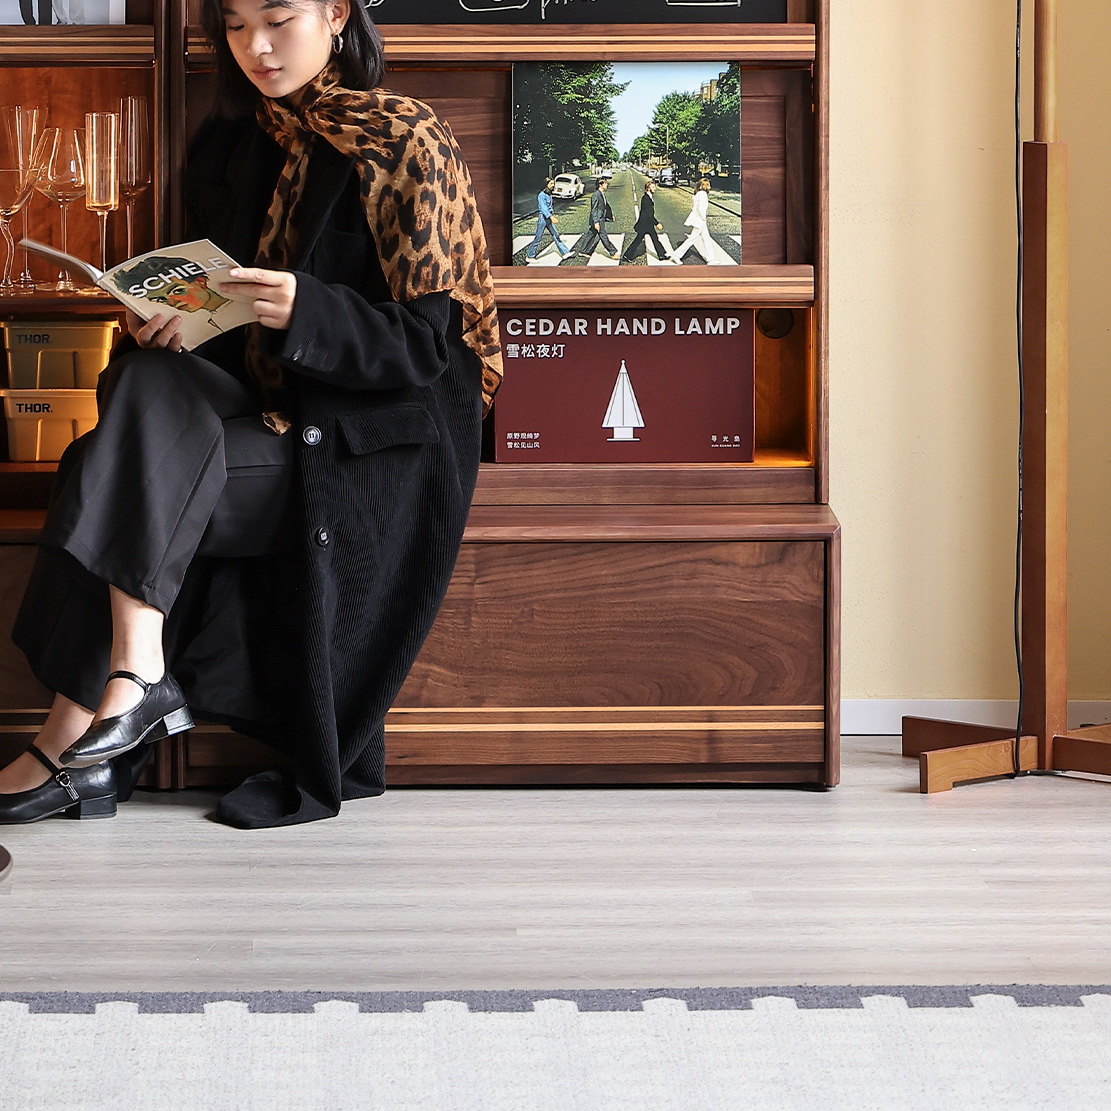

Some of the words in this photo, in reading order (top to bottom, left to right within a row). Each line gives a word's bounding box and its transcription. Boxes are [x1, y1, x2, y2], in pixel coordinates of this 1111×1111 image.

[128, 257, 229, 299] SCHIELE
[506, 317, 589, 337] CEDAR
[596, 317, 667, 336] HAND
[674, 316, 741, 336] LAMP
[505, 343, 566, 359] 雪松夜灯
[15, 403, 54, 413] THOR.
[506, 441, 540, 449] 雪松见山风
